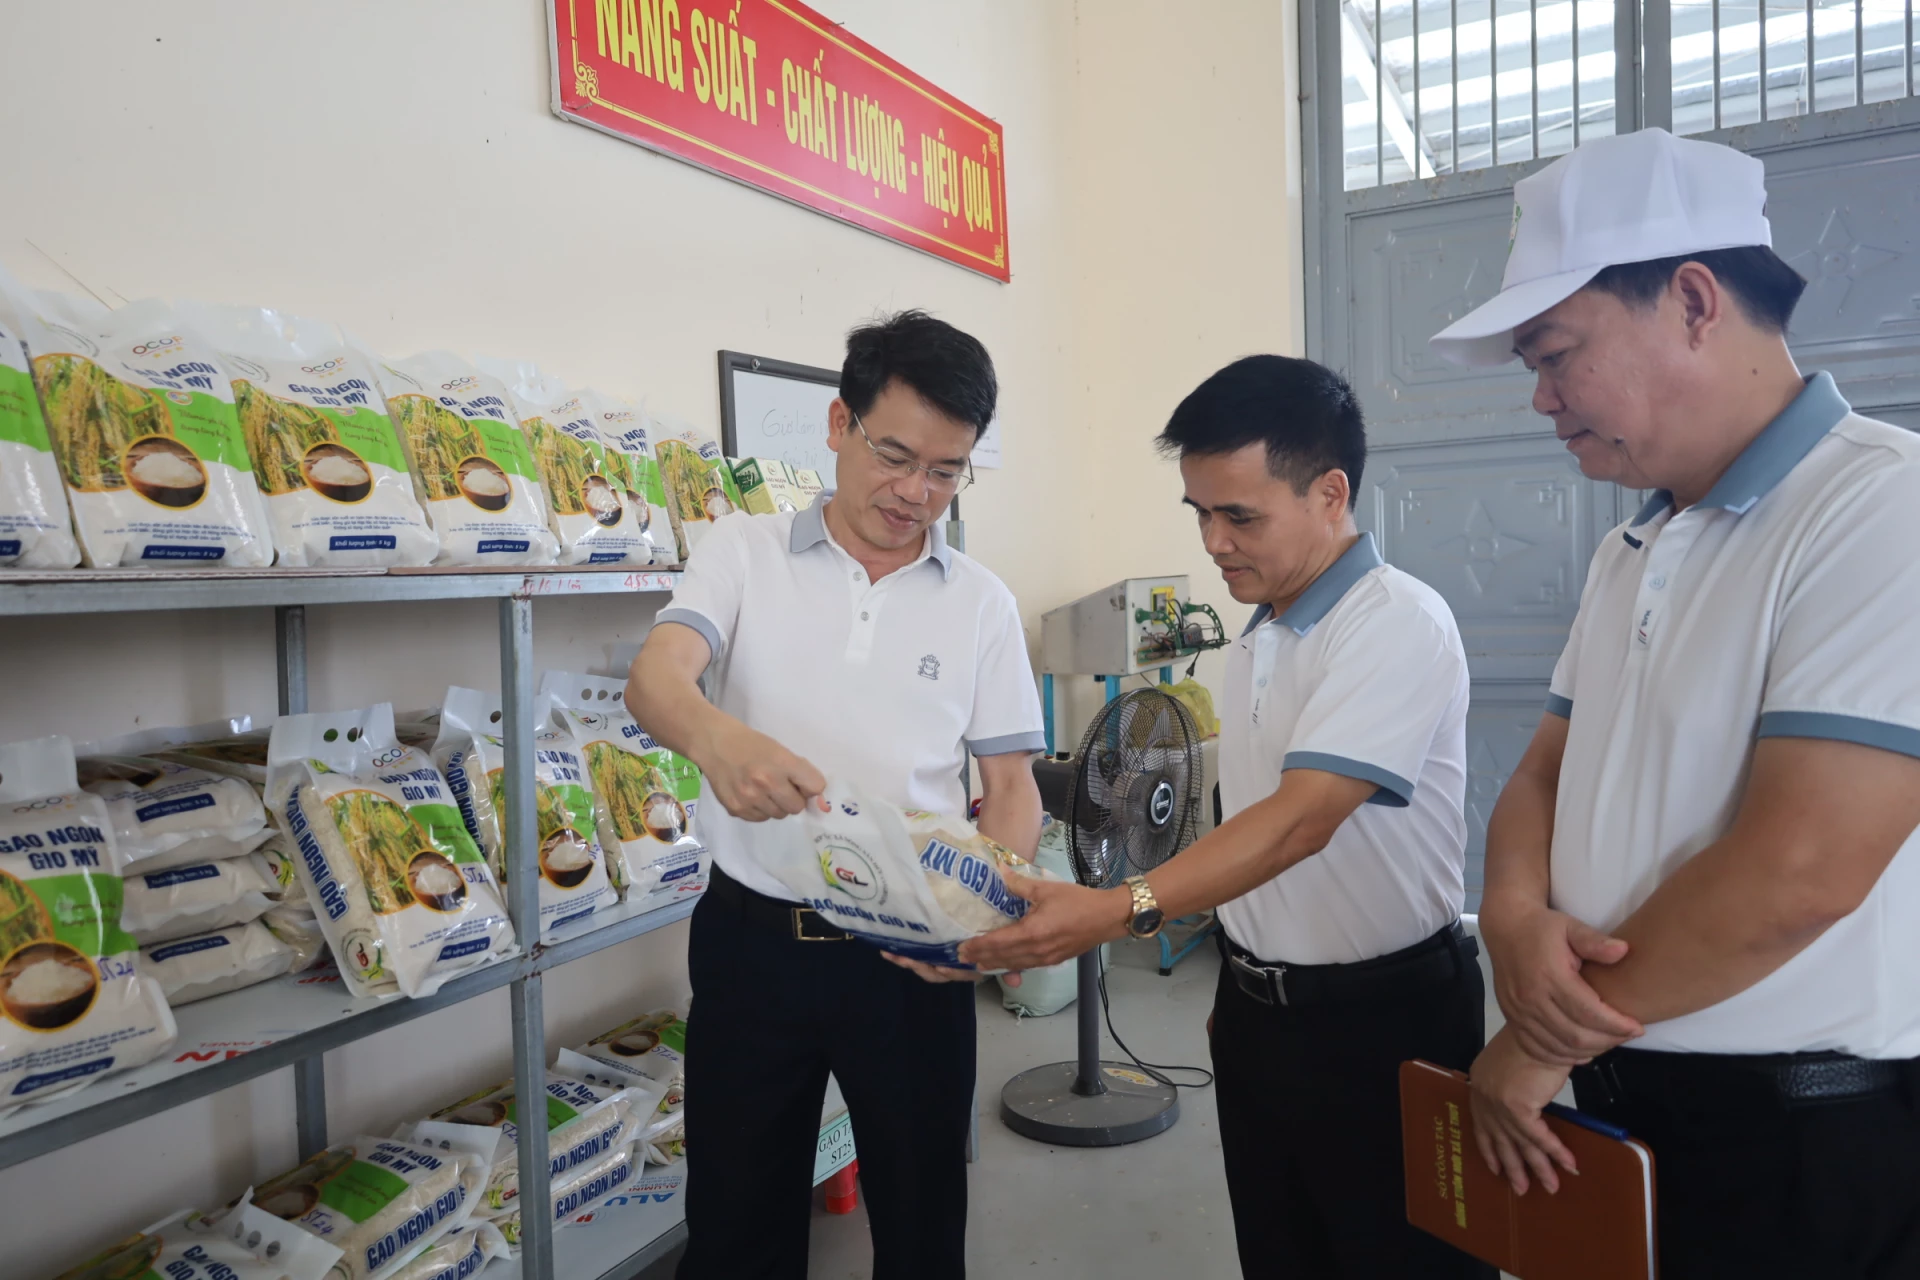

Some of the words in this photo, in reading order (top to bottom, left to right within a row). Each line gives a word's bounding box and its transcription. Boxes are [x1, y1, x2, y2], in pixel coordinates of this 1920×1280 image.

[691, 0, 757, 125] SUẤT
[766, 88, 775, 107] -
[782, 49, 838, 162] CHẤT
[843, 92, 906, 198] LƯỢNG
[911, 161, 918, 176] -
[921, 132, 958, 229] HIỆU
[963, 144, 993, 232] QUẢ
[162, 362, 218, 379] NGON
[302, 357, 346, 374] OCOP
[325, 379, 371, 395] NGON
[312, 395, 341, 406] GIO
[467, 396, 505, 409] NGON
[402, 786, 425, 801] GIO
[46, 826, 105, 846] NGON
[28, 852, 67, 870] GIO
[298, 832, 331, 885] NGON
[959, 855, 988, 893] GIO
[570, 1137, 599, 1167] NGON
[831, 1139, 852, 1165] ST25
[1434, 1143, 1447, 1180] CÔNG
[580, 1175, 609, 1205] NGON
[611, 1164, 627, 1187] GIO
[397, 1206, 434, 1248] NGON
[436, 1190, 457, 1220] GIO
